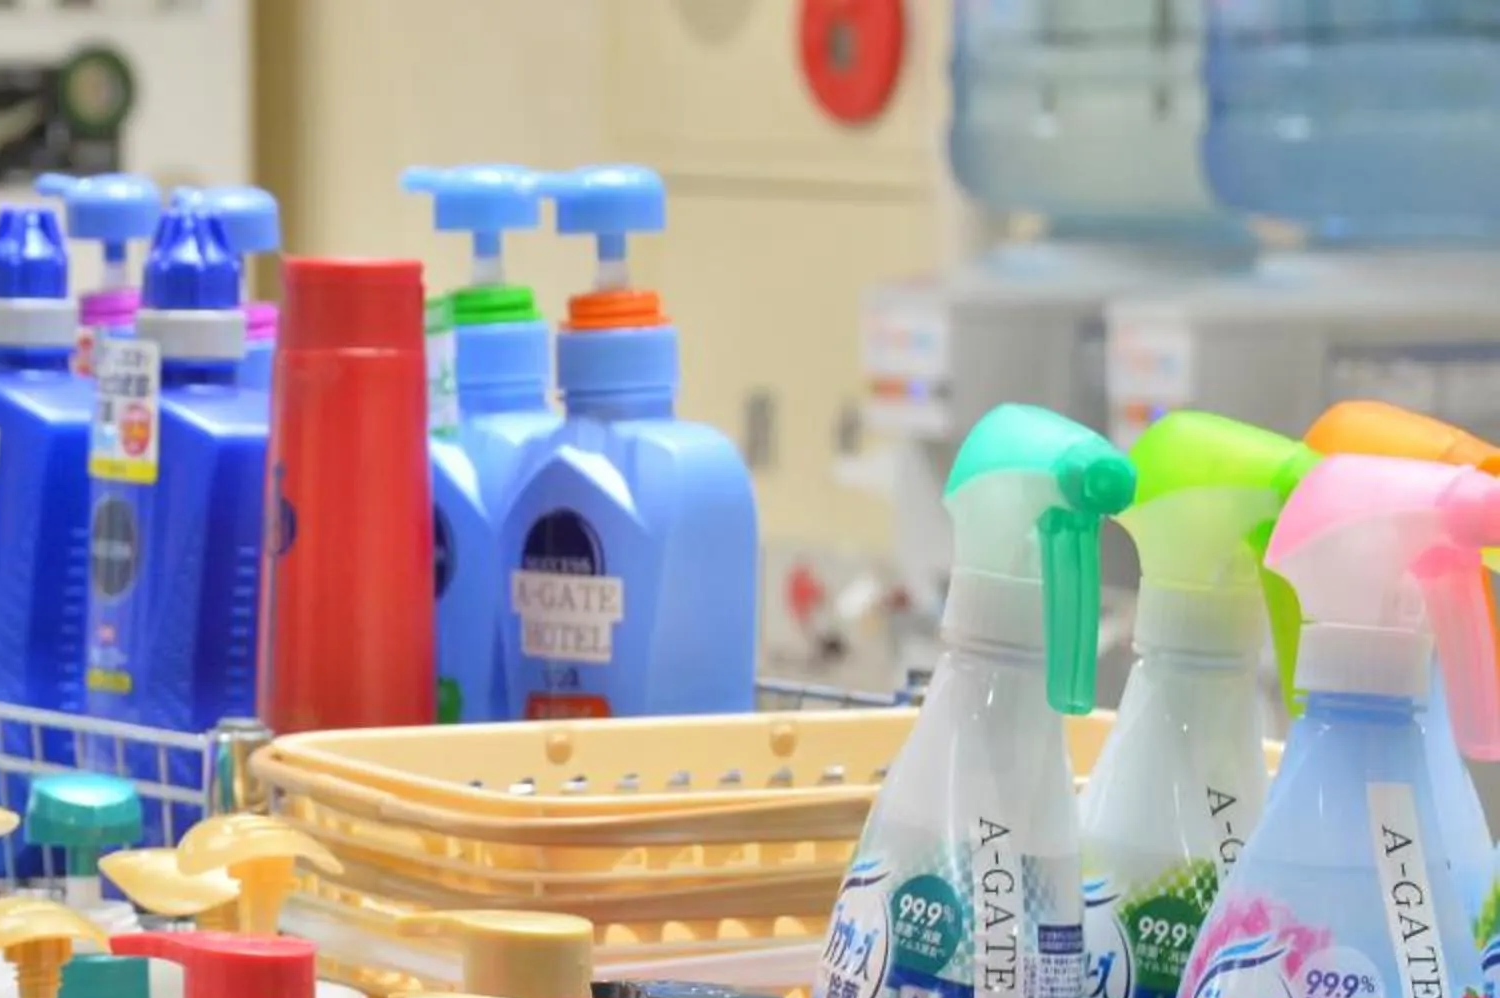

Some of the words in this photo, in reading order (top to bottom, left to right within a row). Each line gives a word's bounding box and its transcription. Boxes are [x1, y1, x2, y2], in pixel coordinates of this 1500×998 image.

[517, 579, 618, 613] A-GATE
[1206, 785, 1246, 876] A-G
[979, 816, 1016, 991] A-GATE
[1306, 968, 1375, 998] 99.9%
